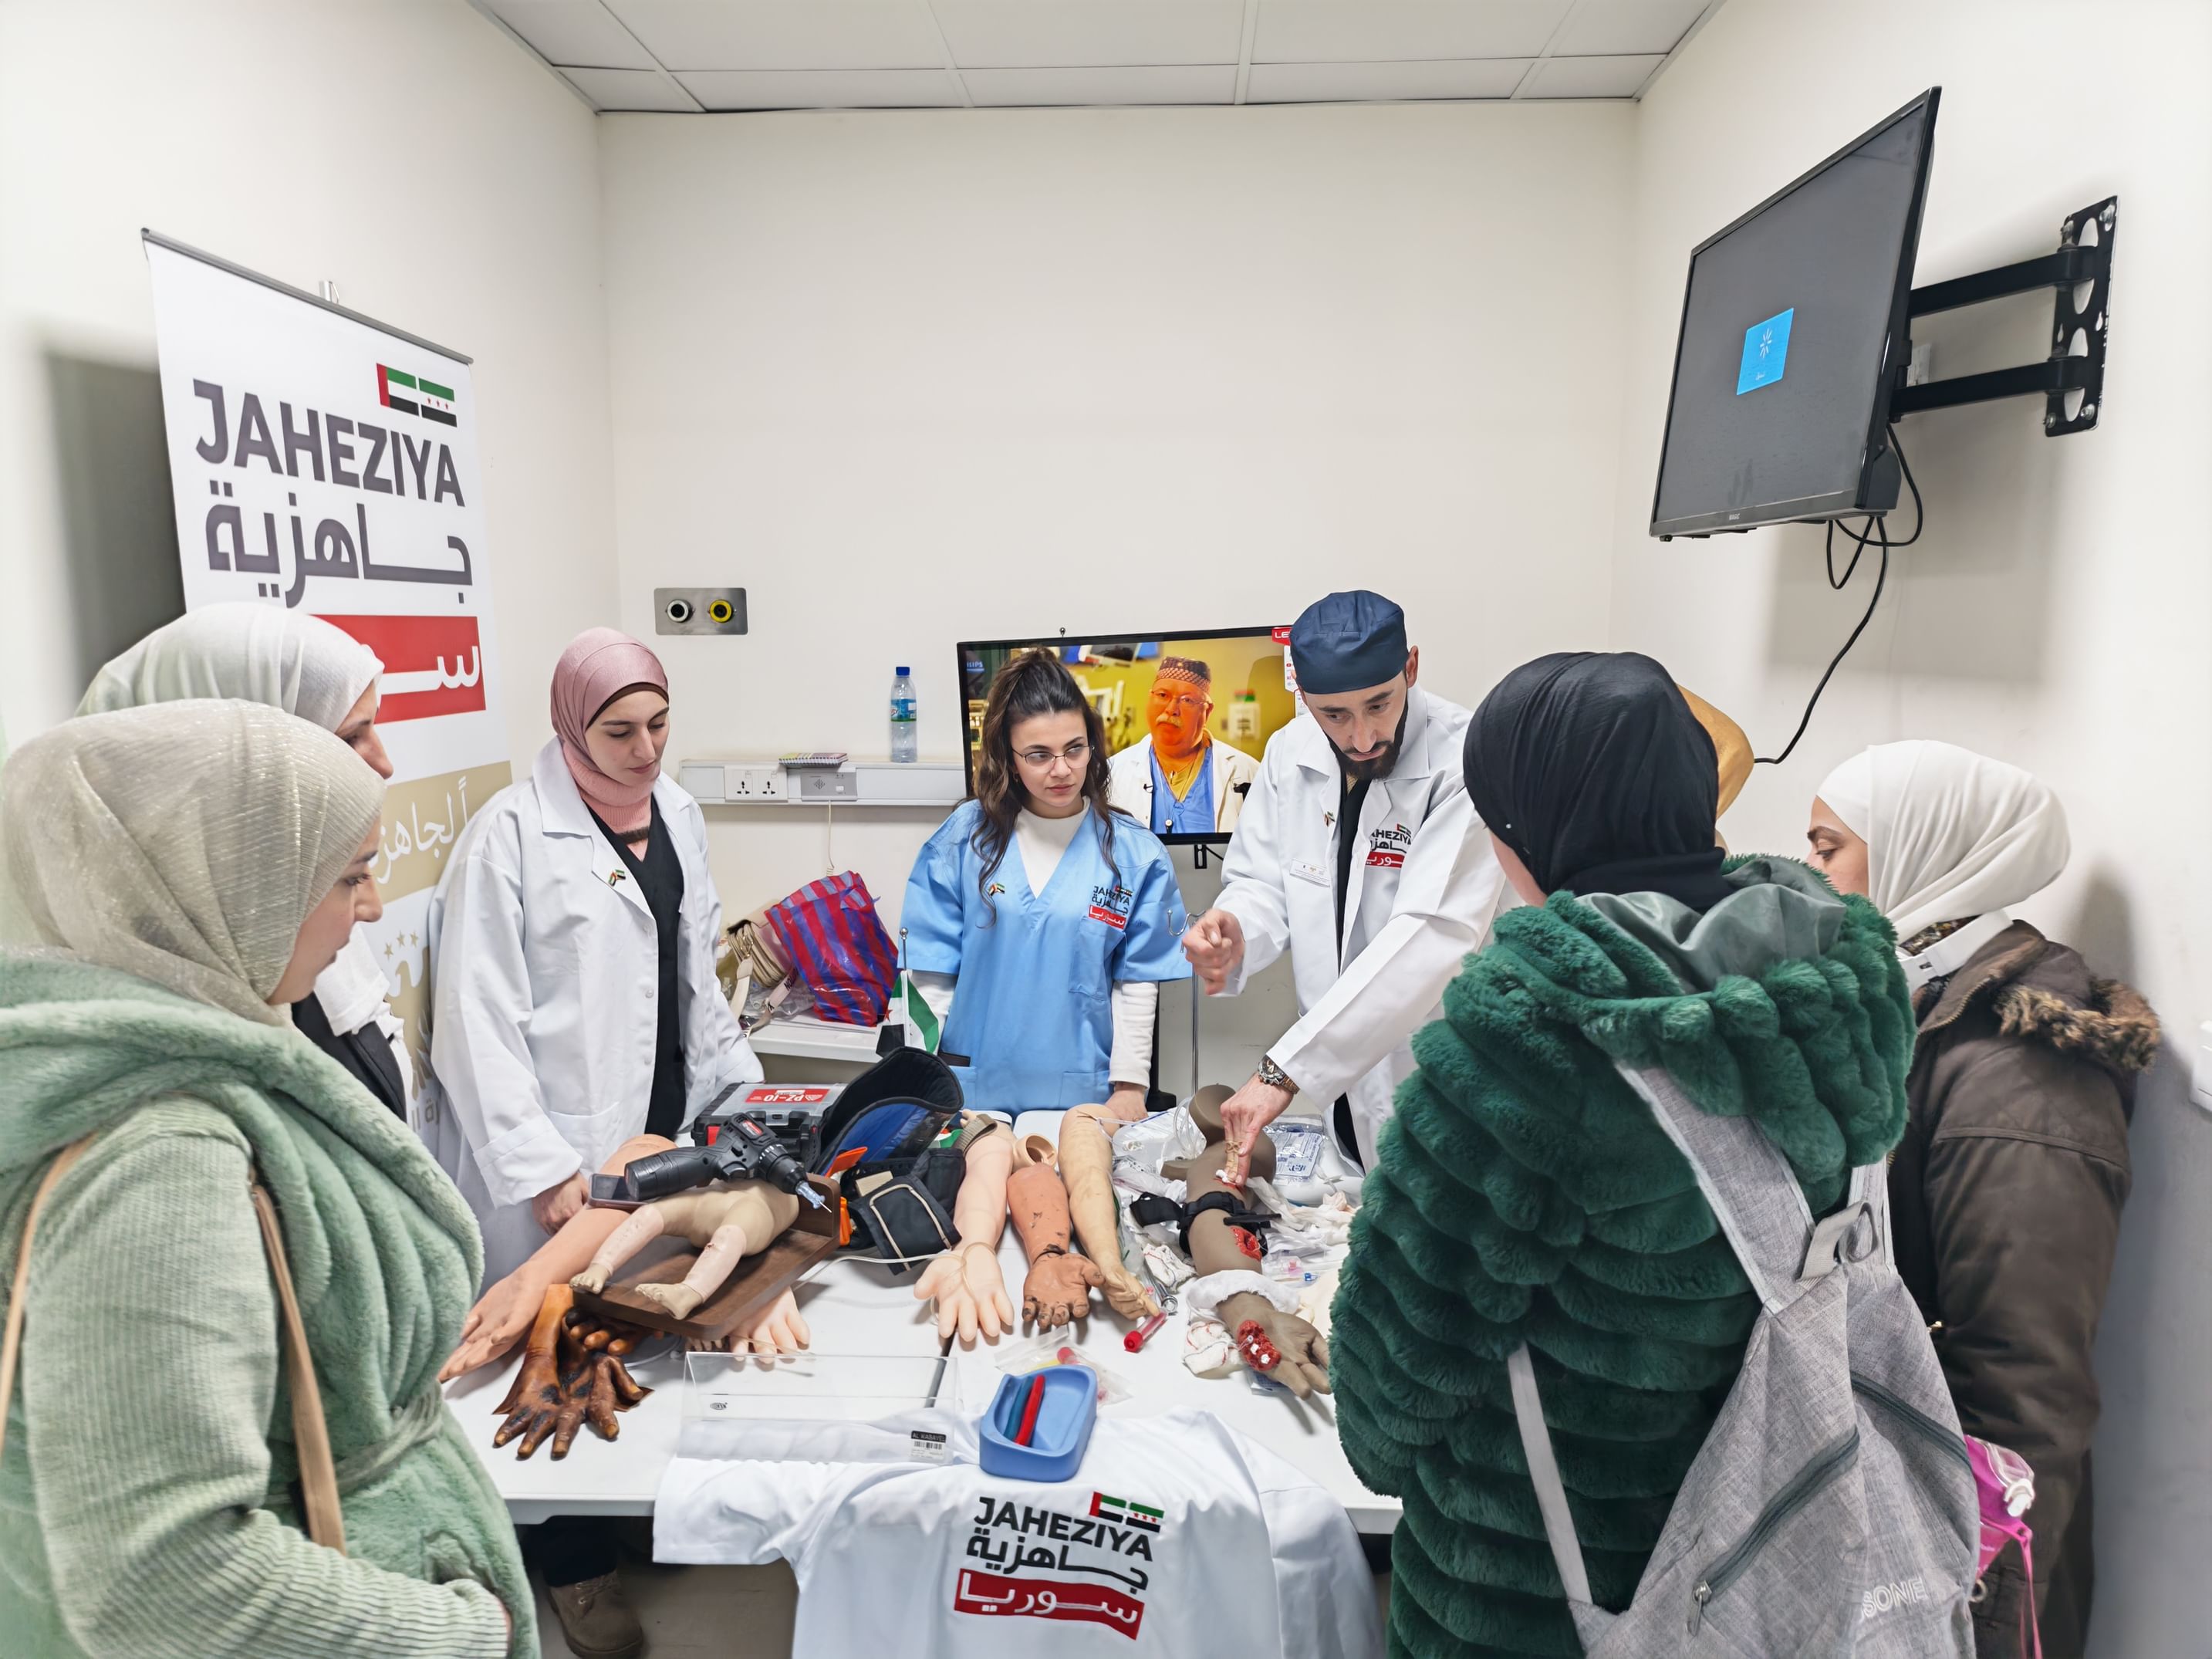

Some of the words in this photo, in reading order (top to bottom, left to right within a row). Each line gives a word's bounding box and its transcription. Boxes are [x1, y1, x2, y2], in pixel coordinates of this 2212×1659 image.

[192, 378, 465, 507] JAHEZIYA
[205, 480, 473, 607] جاهزية
[966, 1527, 1150, 1595] جاهزية
[973, 1496, 1153, 1562] JAHEZIYA
[960, 1573, 1138, 1624] سوريا
[1859, 1575, 1930, 1623] SONE
